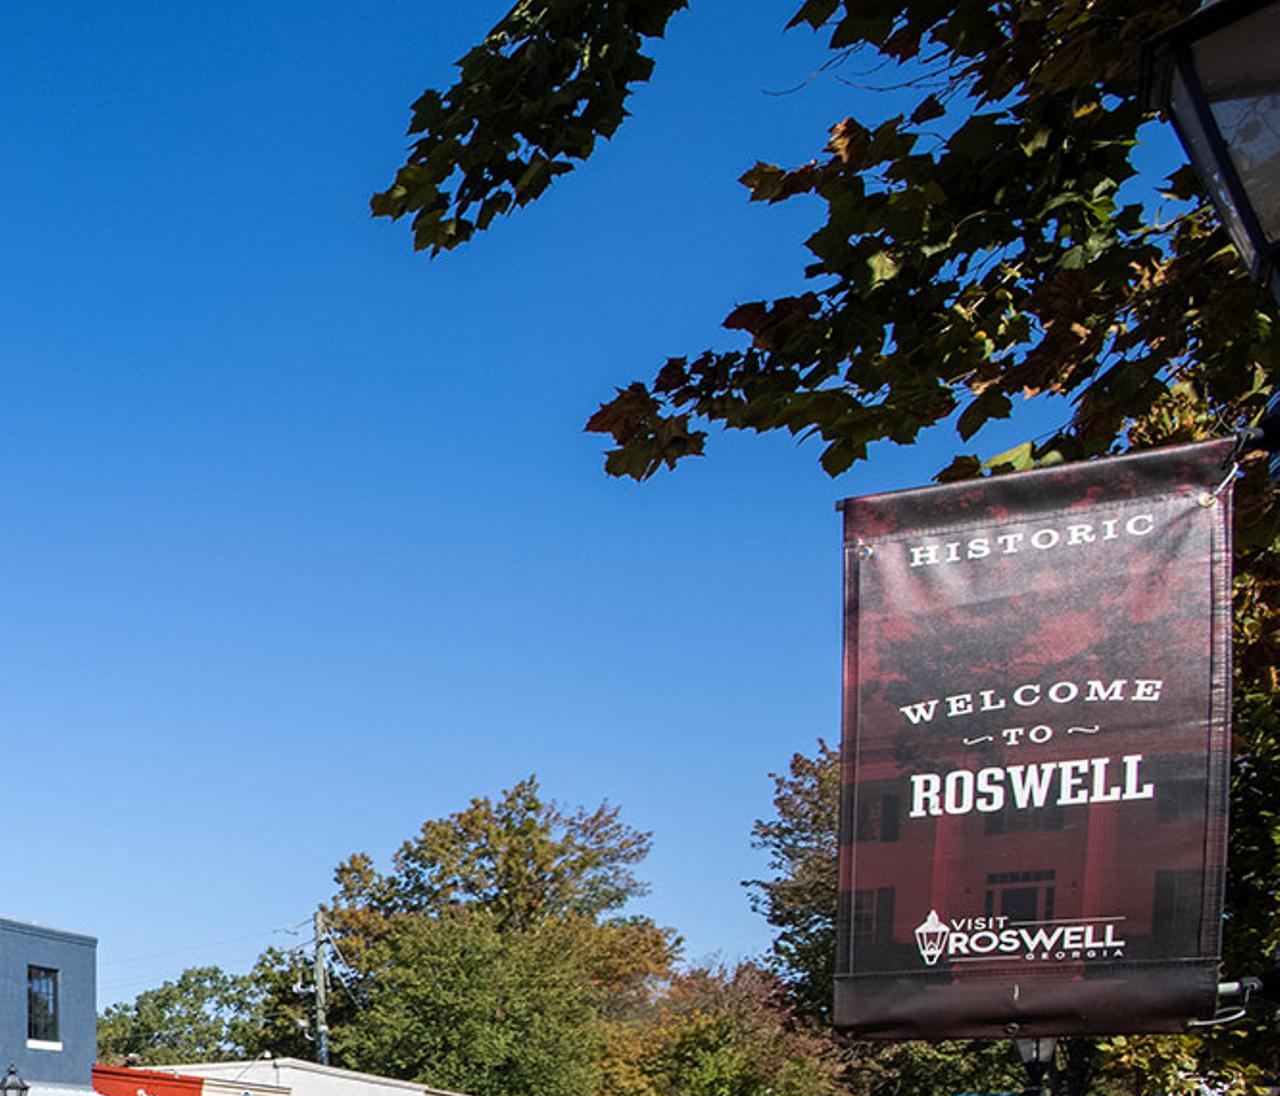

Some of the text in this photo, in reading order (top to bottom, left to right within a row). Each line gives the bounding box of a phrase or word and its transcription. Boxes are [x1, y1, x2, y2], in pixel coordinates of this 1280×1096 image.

[910, 512, 1157, 568] HISTORIC
[899, 678, 1164, 725] WELCOME
[1002, 723, 1054, 746] TO
[908, 753, 1156, 819] ROSWELL
[951, 916, 1008, 931] VISIT
[948, 925, 1125, 954] ROSWELL
[1026, 949, 1124, 960] GEORGIA
